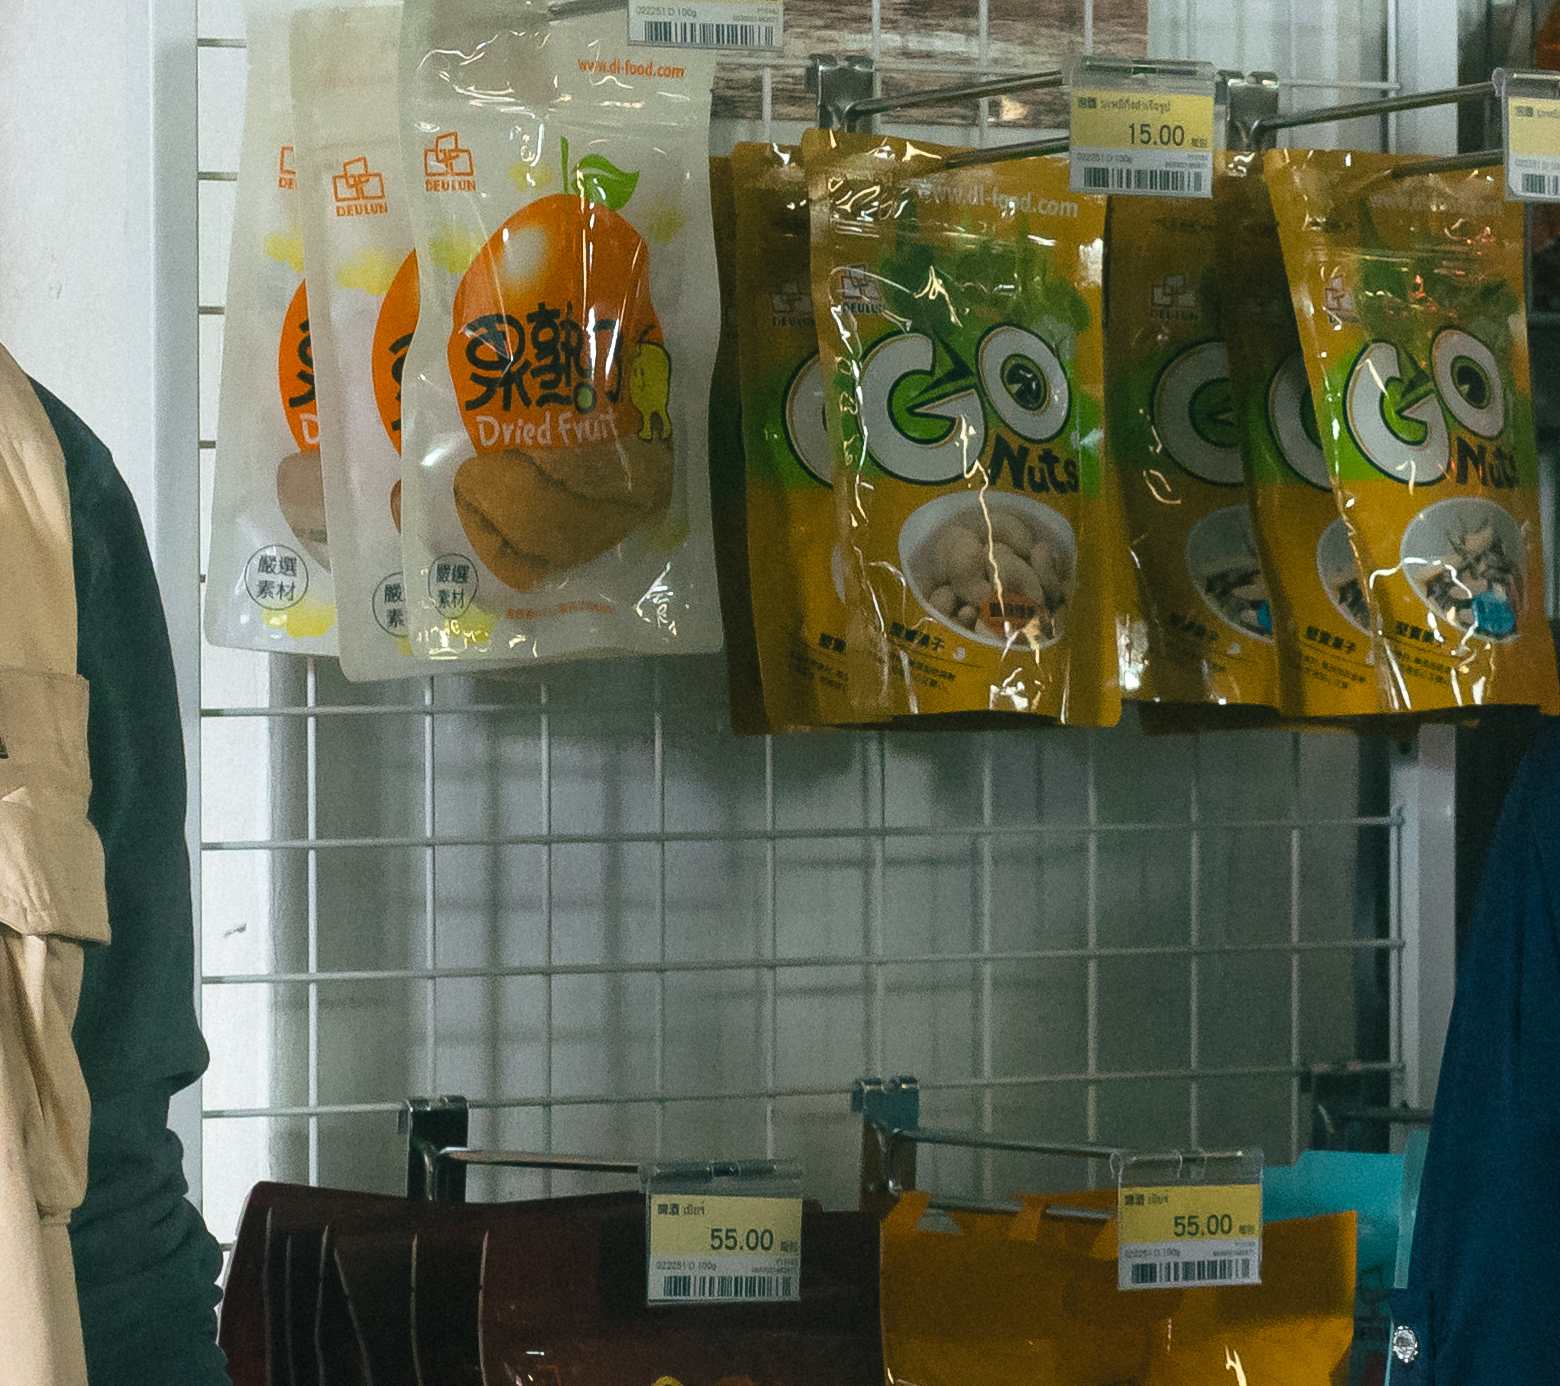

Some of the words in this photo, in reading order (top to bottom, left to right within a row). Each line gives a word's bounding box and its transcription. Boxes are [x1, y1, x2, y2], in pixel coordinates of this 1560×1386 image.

[1128, 123, 1185, 146] 15.00
[424, 179, 476, 192] DEULUN
[335, 202, 389, 217] DEULUN
[476, 411, 550, 447] Dried
[989, 433, 1080, 494] Nuts
[1173, 1213, 1233, 1237] 55.00
[710, 1227, 774, 1251] 55.00
